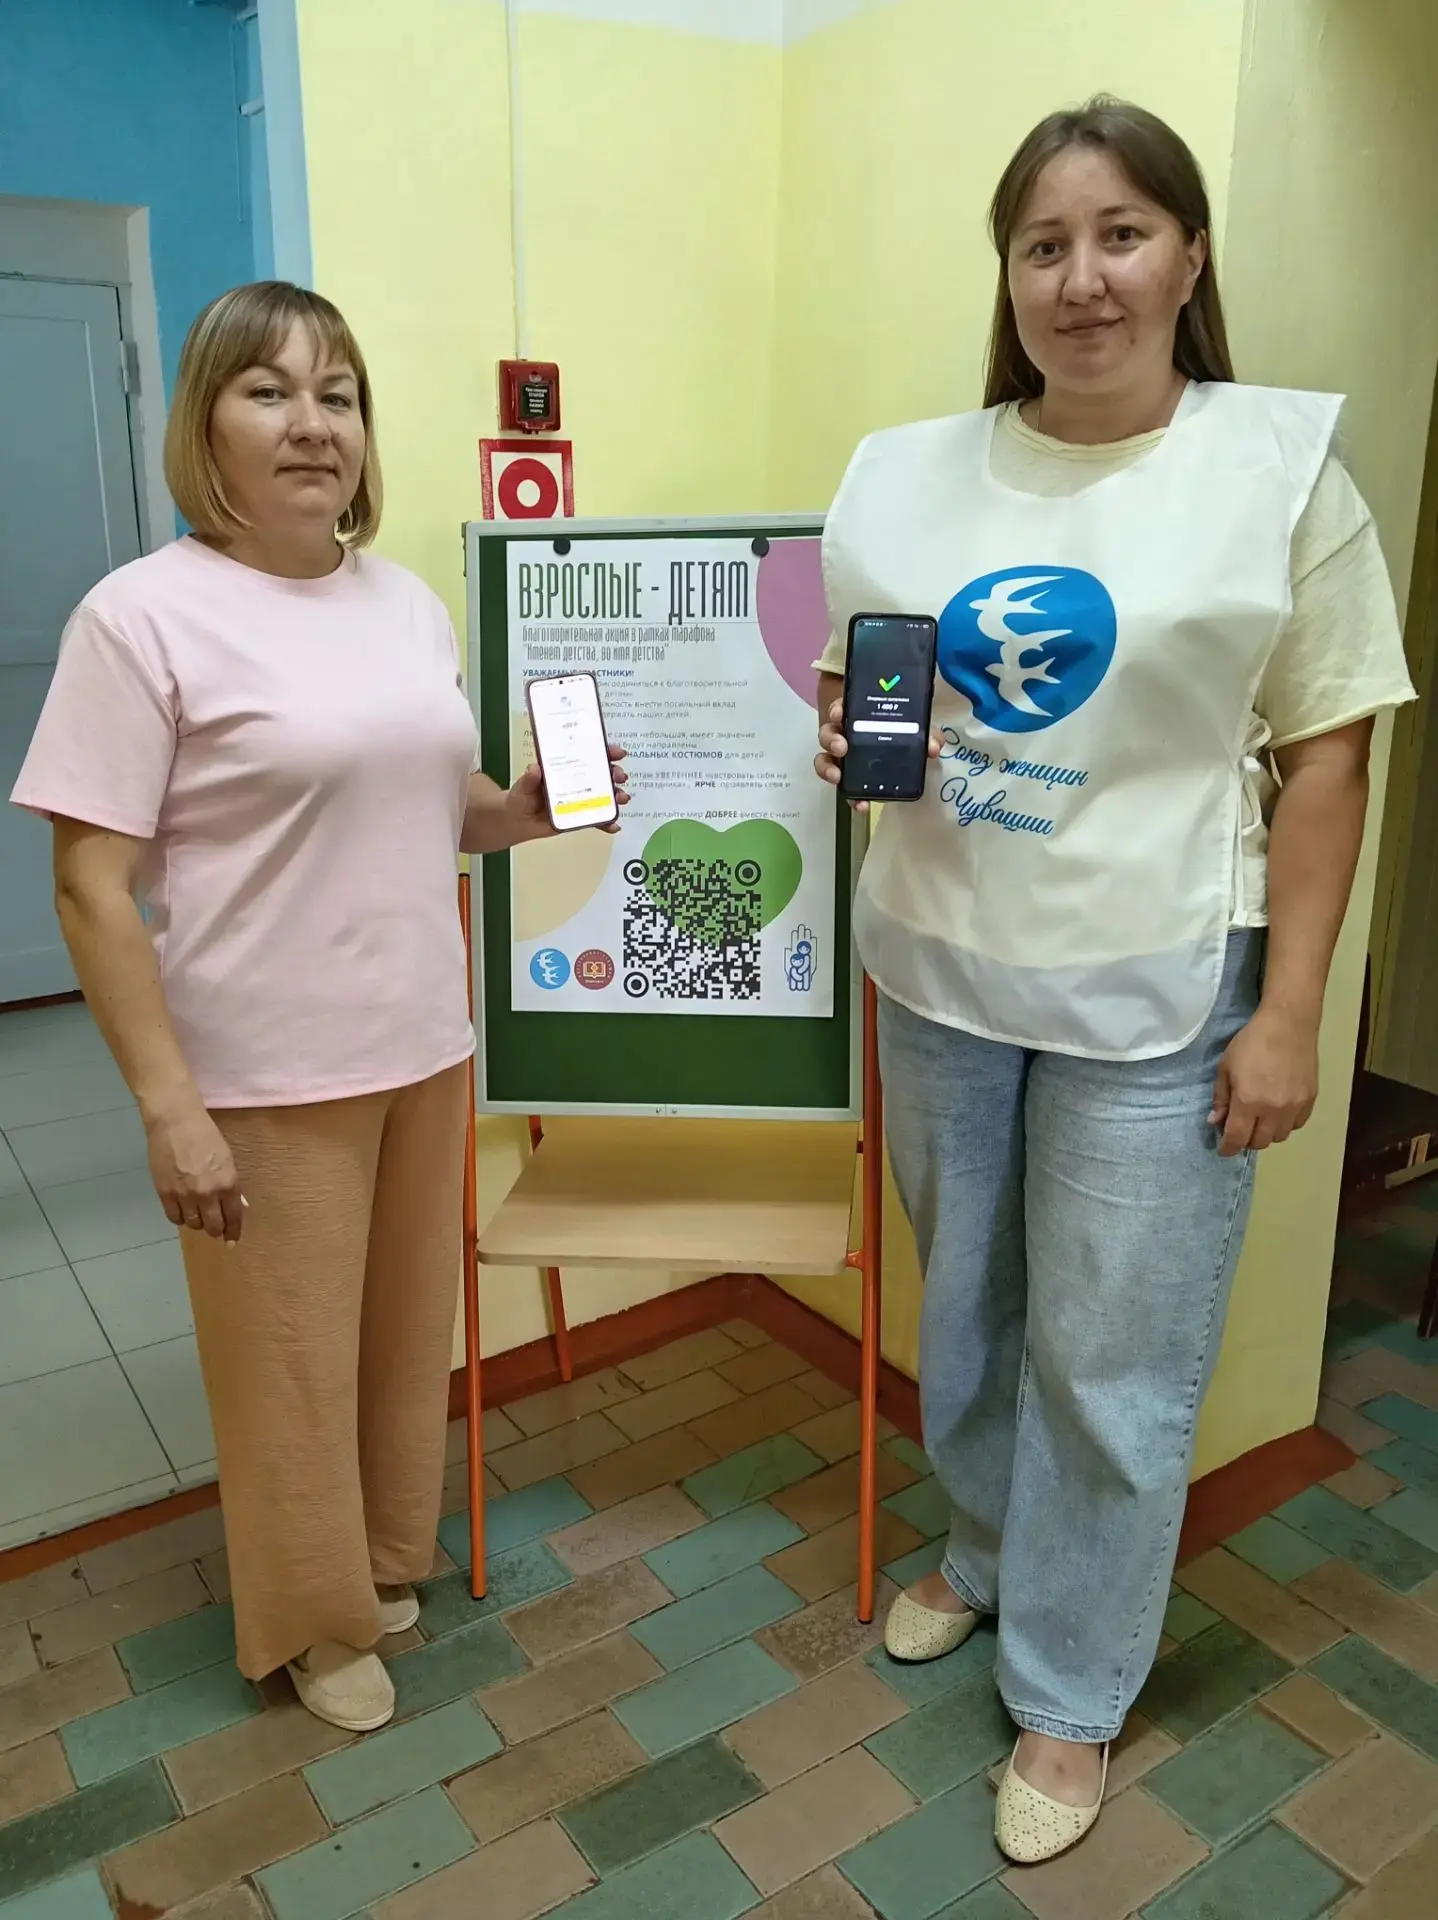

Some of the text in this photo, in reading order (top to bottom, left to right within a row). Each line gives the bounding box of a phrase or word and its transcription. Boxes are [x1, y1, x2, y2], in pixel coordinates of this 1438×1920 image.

[519, 562, 643, 619] ВЗРОСЛЫЕ
[668, 561, 749, 625] ДЕТЯМ
[605, 626, 630, 644] акция
[671, 624, 715, 645] марафона
[712, 701, 736, 709] вклад
[672, 751, 723, 759] КОСТЮМОВ
[938, 724, 1089, 791] Союз женщин
[705, 810, 737, 819] ДОБРЕЕ
[940, 776, 1053, 835] Чувашии
